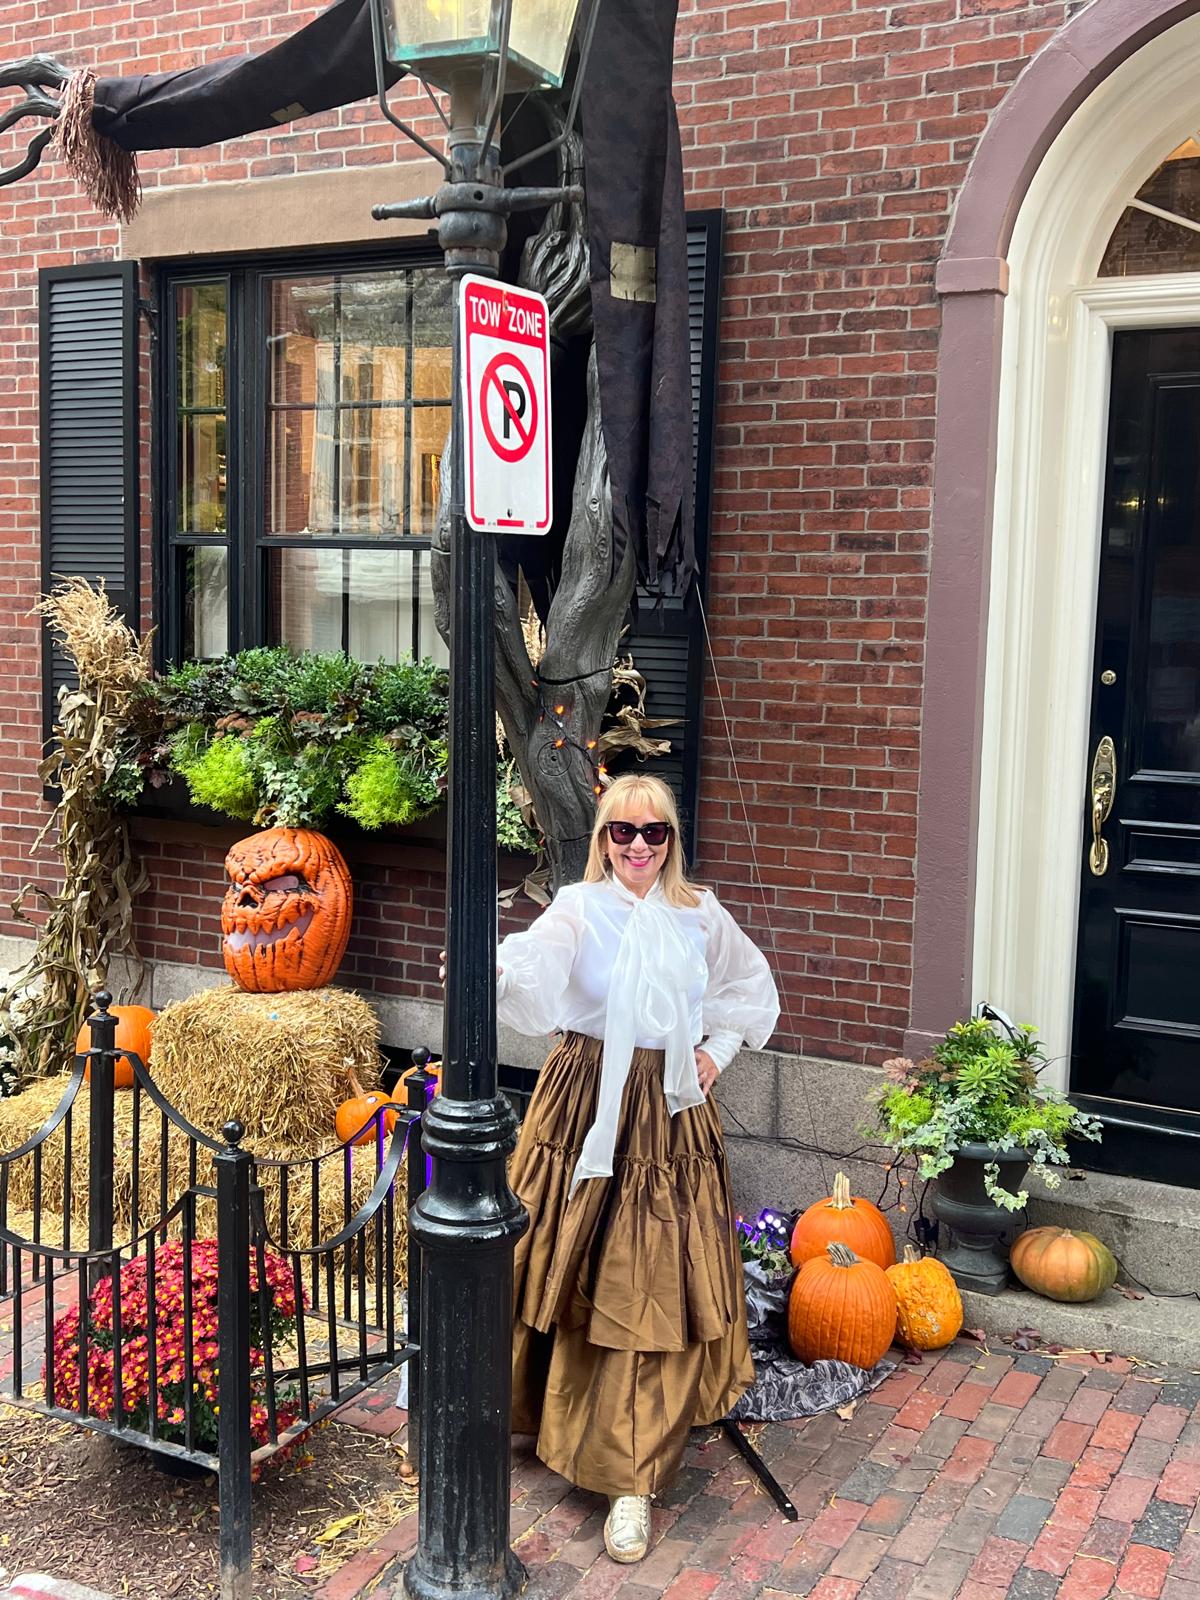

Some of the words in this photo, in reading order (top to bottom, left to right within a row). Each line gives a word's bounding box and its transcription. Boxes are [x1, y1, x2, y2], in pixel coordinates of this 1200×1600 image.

[469, 295, 501, 328] TOW
[507, 305, 543, 339] ZONE
[503, 380, 526, 439] P
